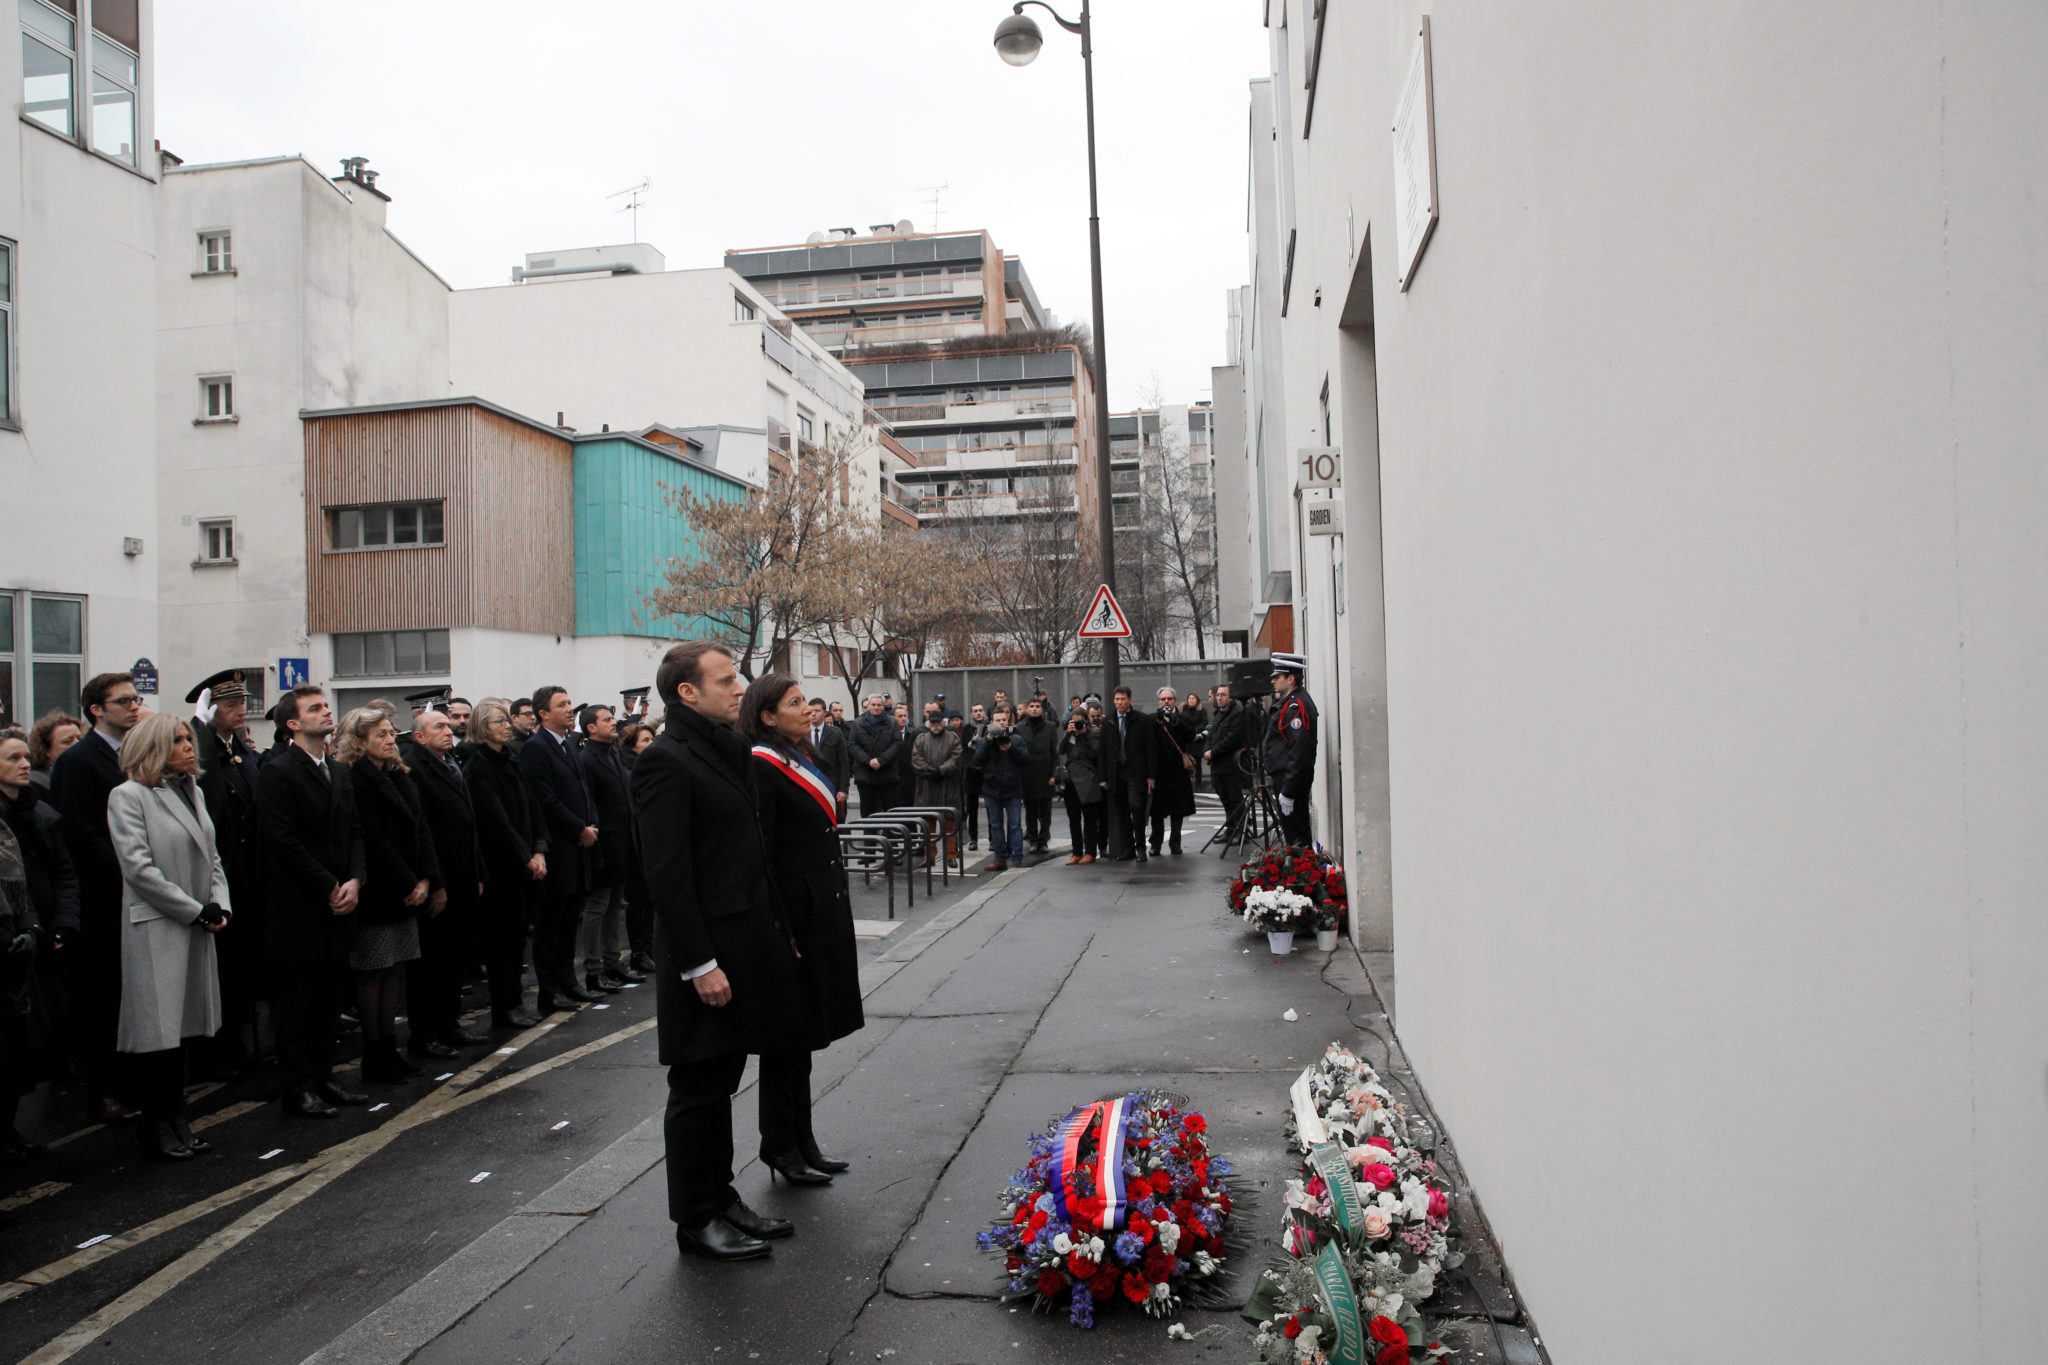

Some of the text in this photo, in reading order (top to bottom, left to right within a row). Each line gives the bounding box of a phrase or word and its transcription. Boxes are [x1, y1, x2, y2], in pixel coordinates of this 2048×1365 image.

[1302, 454, 1335, 481] 10
[1309, 509, 1331, 526] GARDIEN
[1320, 1260, 1350, 1304] CHARLIE
[1337, 1306, 1358, 1361] HEBDO
